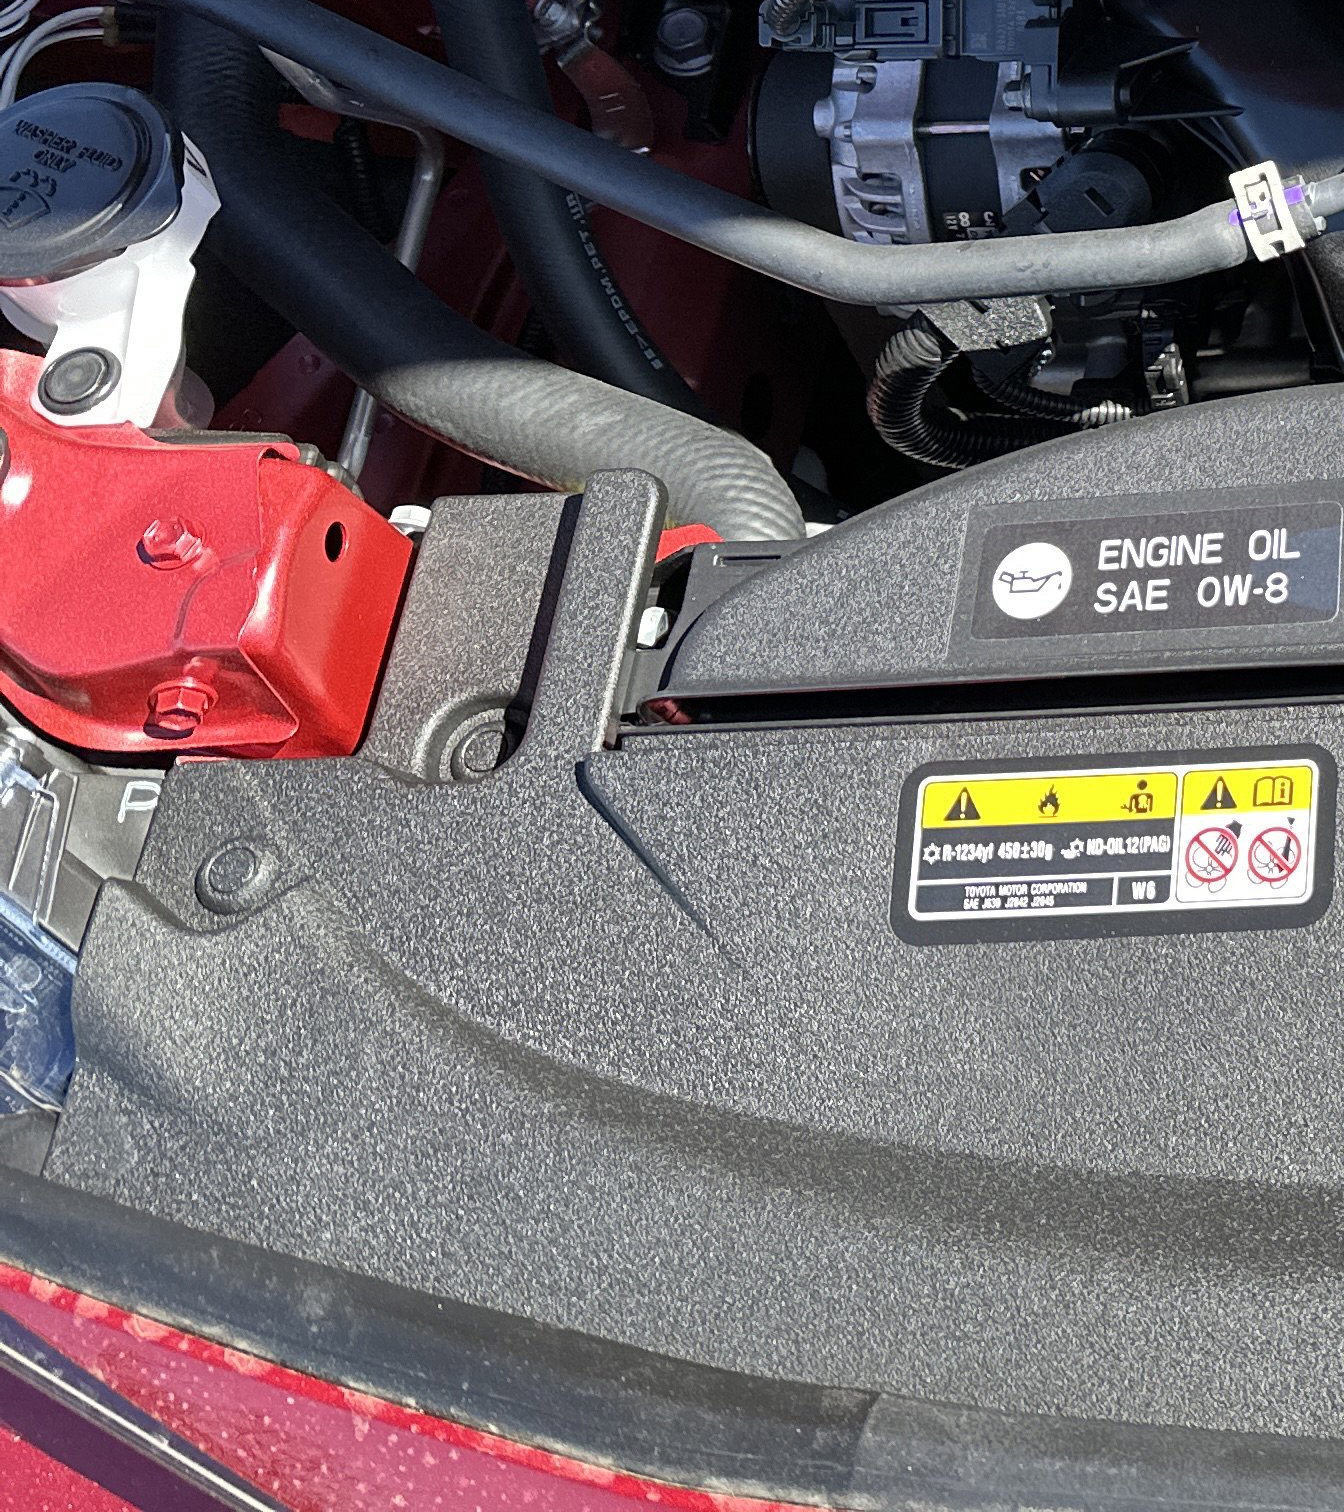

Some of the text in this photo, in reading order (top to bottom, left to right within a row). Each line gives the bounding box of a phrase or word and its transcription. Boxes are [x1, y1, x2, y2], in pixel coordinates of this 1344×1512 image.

[33, 148, 78, 173] ONLY
[1097, 527, 1301, 572] ENGINE OIL
[1093, 571, 1289, 614] SAE 0W-8
[942, 839, 1054, 864] R-1234yf 450±30g
[963, 880, 1088, 899] TOYOTA MOTOR CORPORATION
[1131, 880, 1157, 901] W6
[963, 897, 980, 911] SAE
